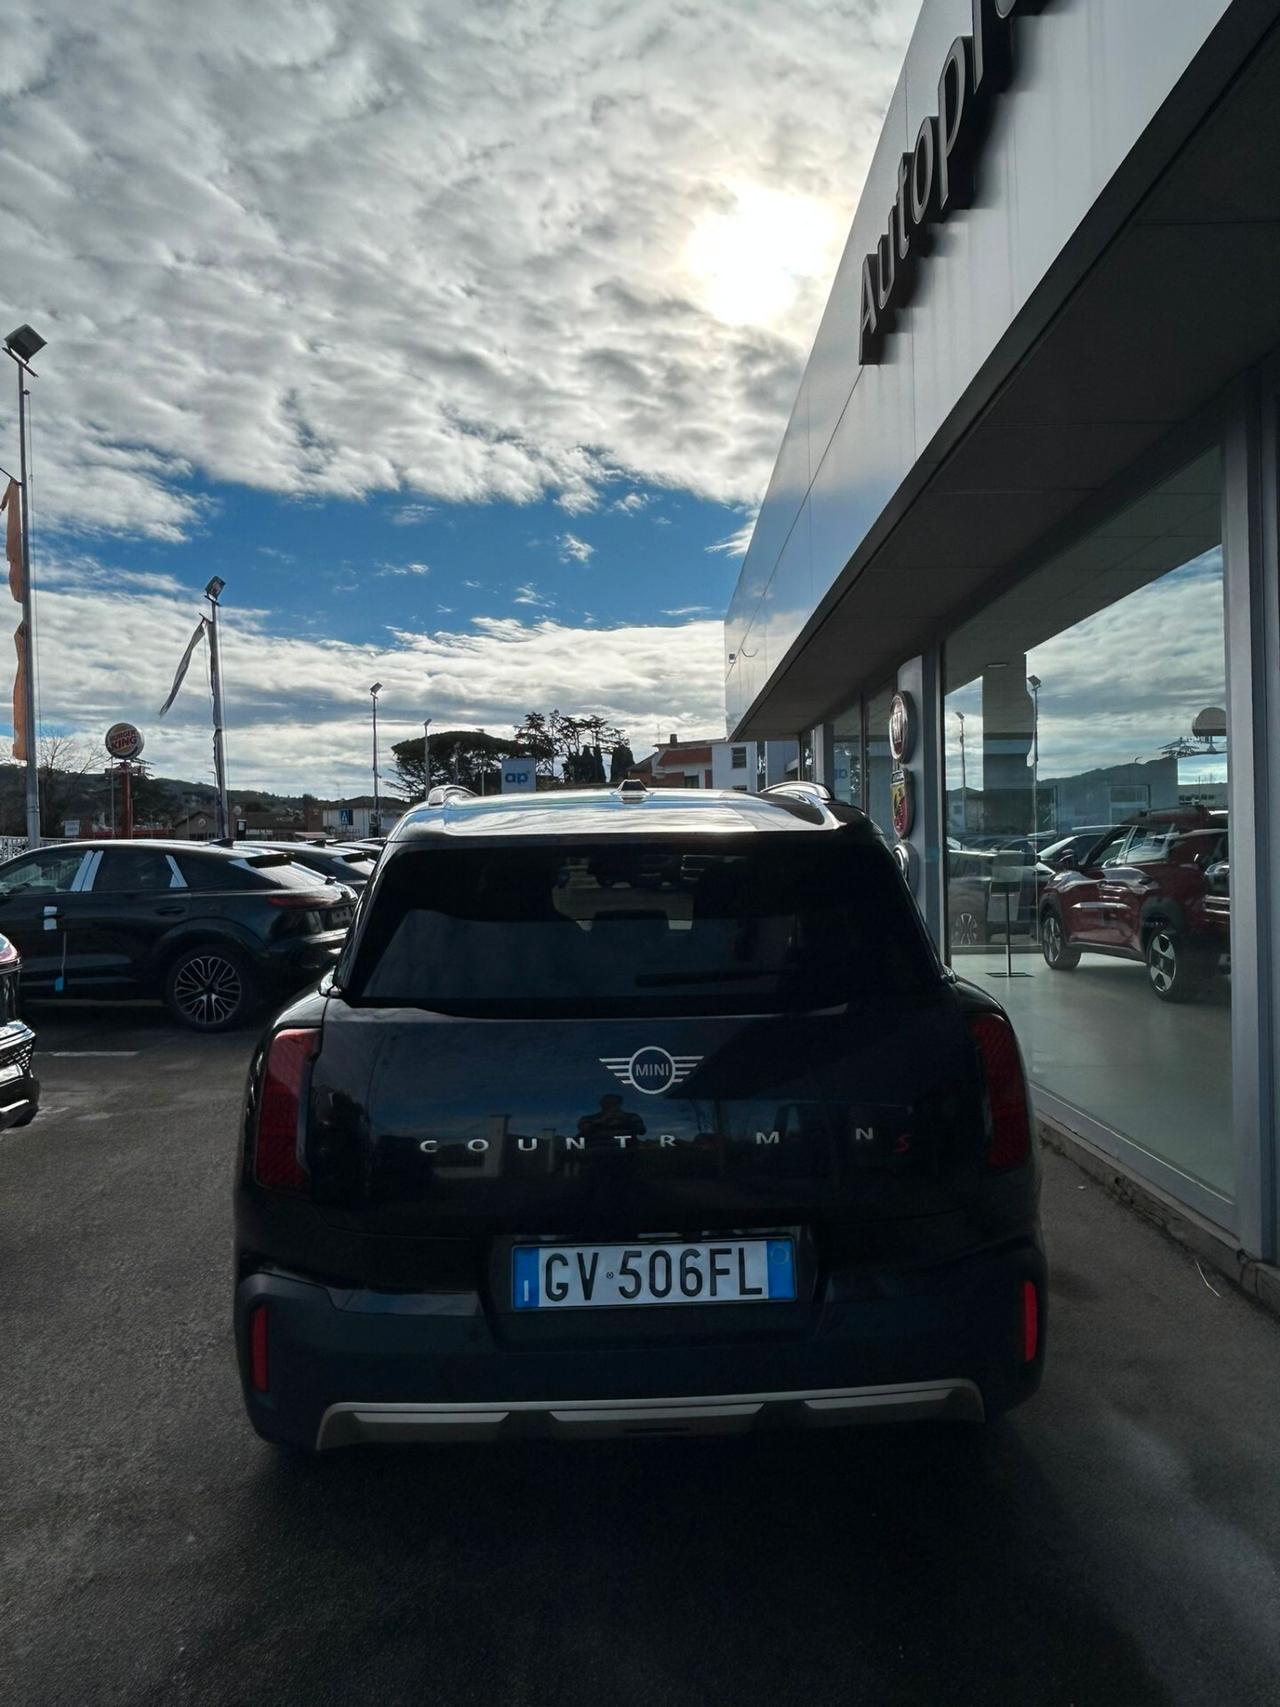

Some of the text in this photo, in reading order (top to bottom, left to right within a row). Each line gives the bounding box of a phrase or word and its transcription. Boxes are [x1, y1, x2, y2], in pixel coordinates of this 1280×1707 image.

[858, 0, 1016, 365] Autop
[111, 736, 137, 749] KING
[635, 1063, 669, 1077] MINI
[420, 1127, 873, 1153] COUNTRMN
[545, 1247, 763, 1302] GV 506FL
